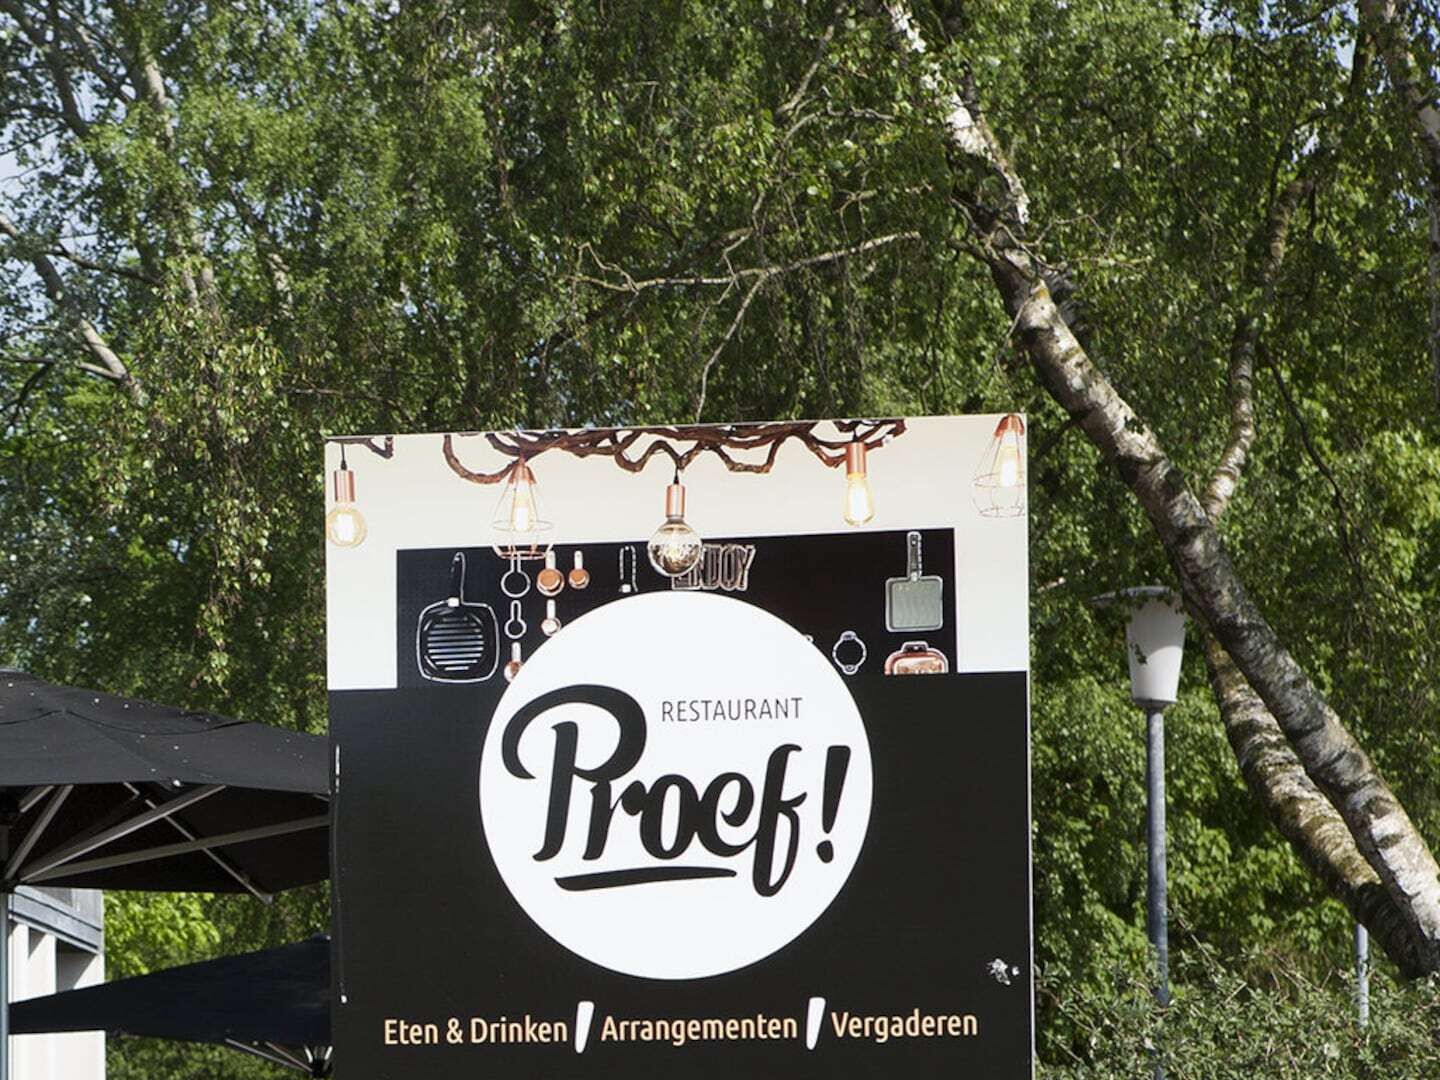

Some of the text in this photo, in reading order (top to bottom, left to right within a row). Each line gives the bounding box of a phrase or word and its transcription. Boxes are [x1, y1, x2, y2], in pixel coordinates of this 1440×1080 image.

[672, 543, 756, 590] NJOY
[662, 697, 803, 722] RESTAURANT
[501, 684, 851, 898] Proef!
[384, 1008, 978, 1047] Eten & Drinken Arrangementen Vergaderen
